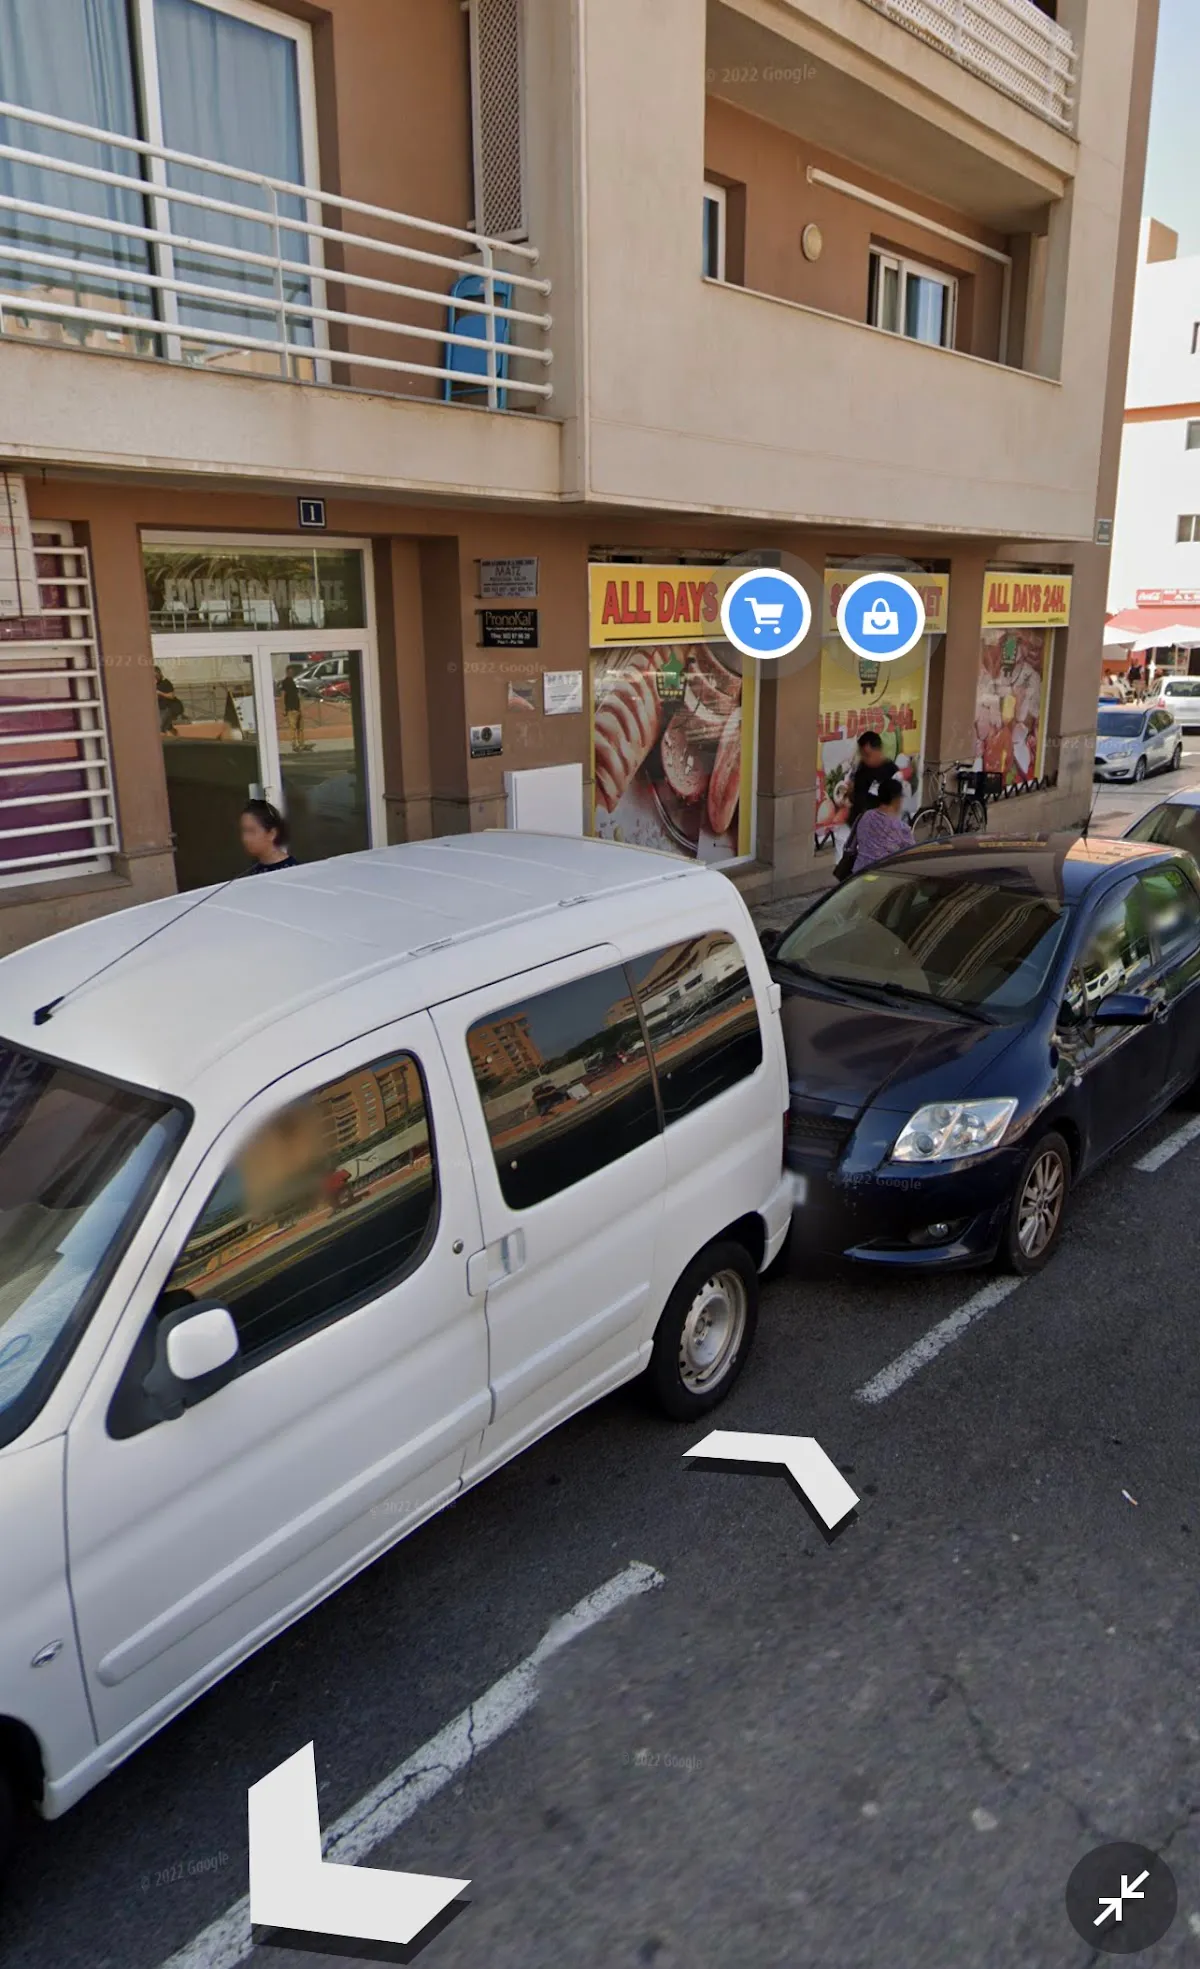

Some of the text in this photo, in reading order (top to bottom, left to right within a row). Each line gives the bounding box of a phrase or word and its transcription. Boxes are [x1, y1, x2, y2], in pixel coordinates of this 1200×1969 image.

[601, 581, 651, 624] ALL
[657, 582, 718, 623] DAYS
[987, 583, 1010, 613] ALL
[1012, 584, 1042, 613] DAYS
